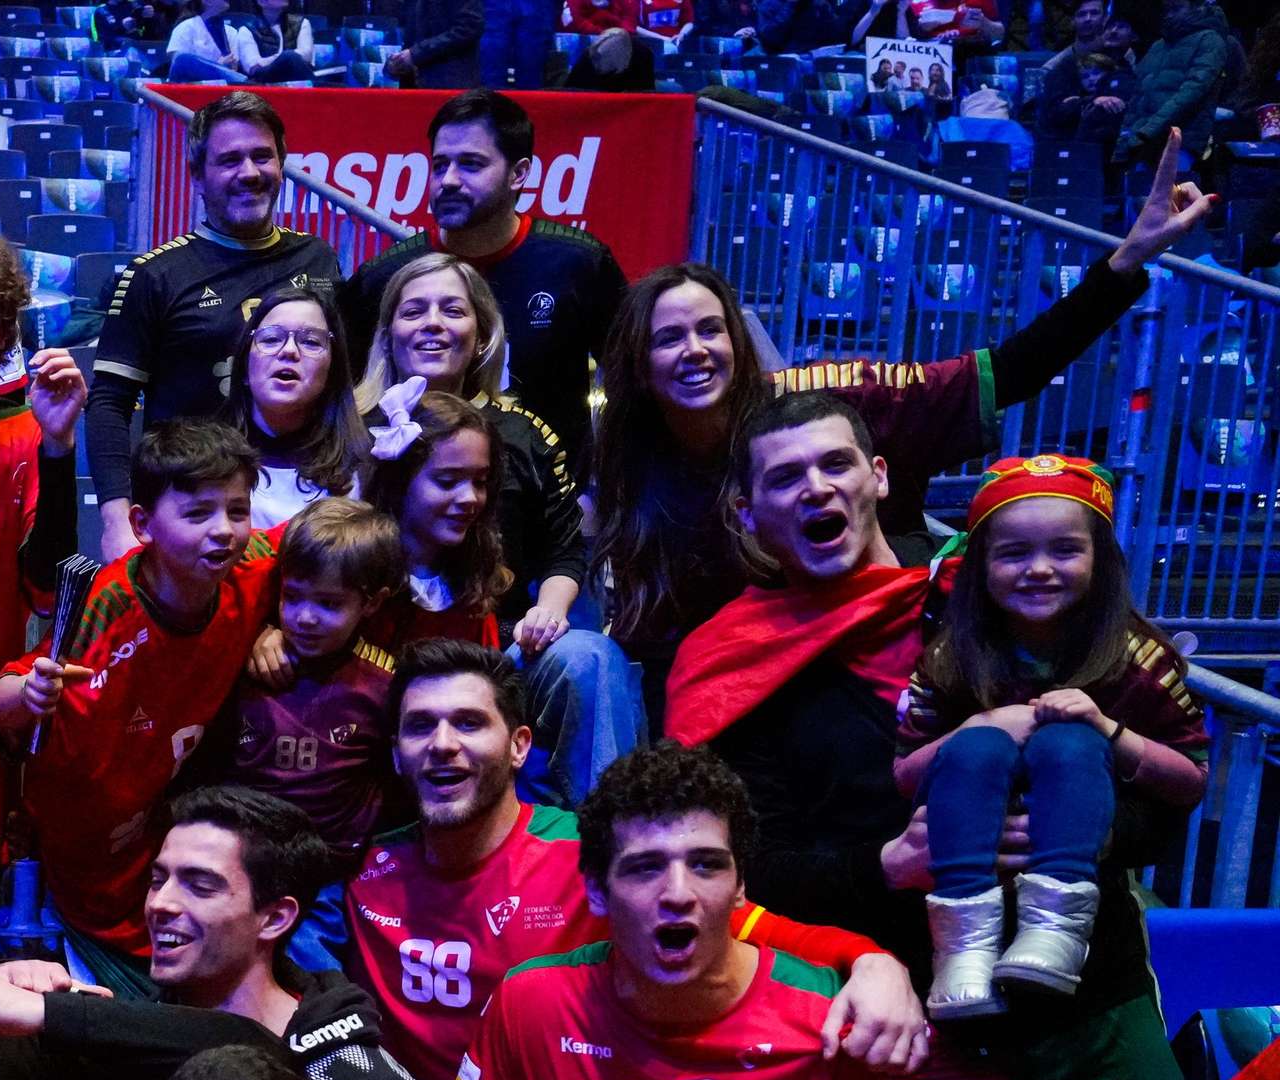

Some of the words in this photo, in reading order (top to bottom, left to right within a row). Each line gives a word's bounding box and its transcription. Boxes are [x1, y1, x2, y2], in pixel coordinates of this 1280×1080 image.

[280, 137, 602, 233] nsped
[198, 299, 223, 308] SELECT
[276, 735, 320, 772] 88
[399, 938, 472, 1009] 88
[289, 1013, 365, 1053] Kempa
